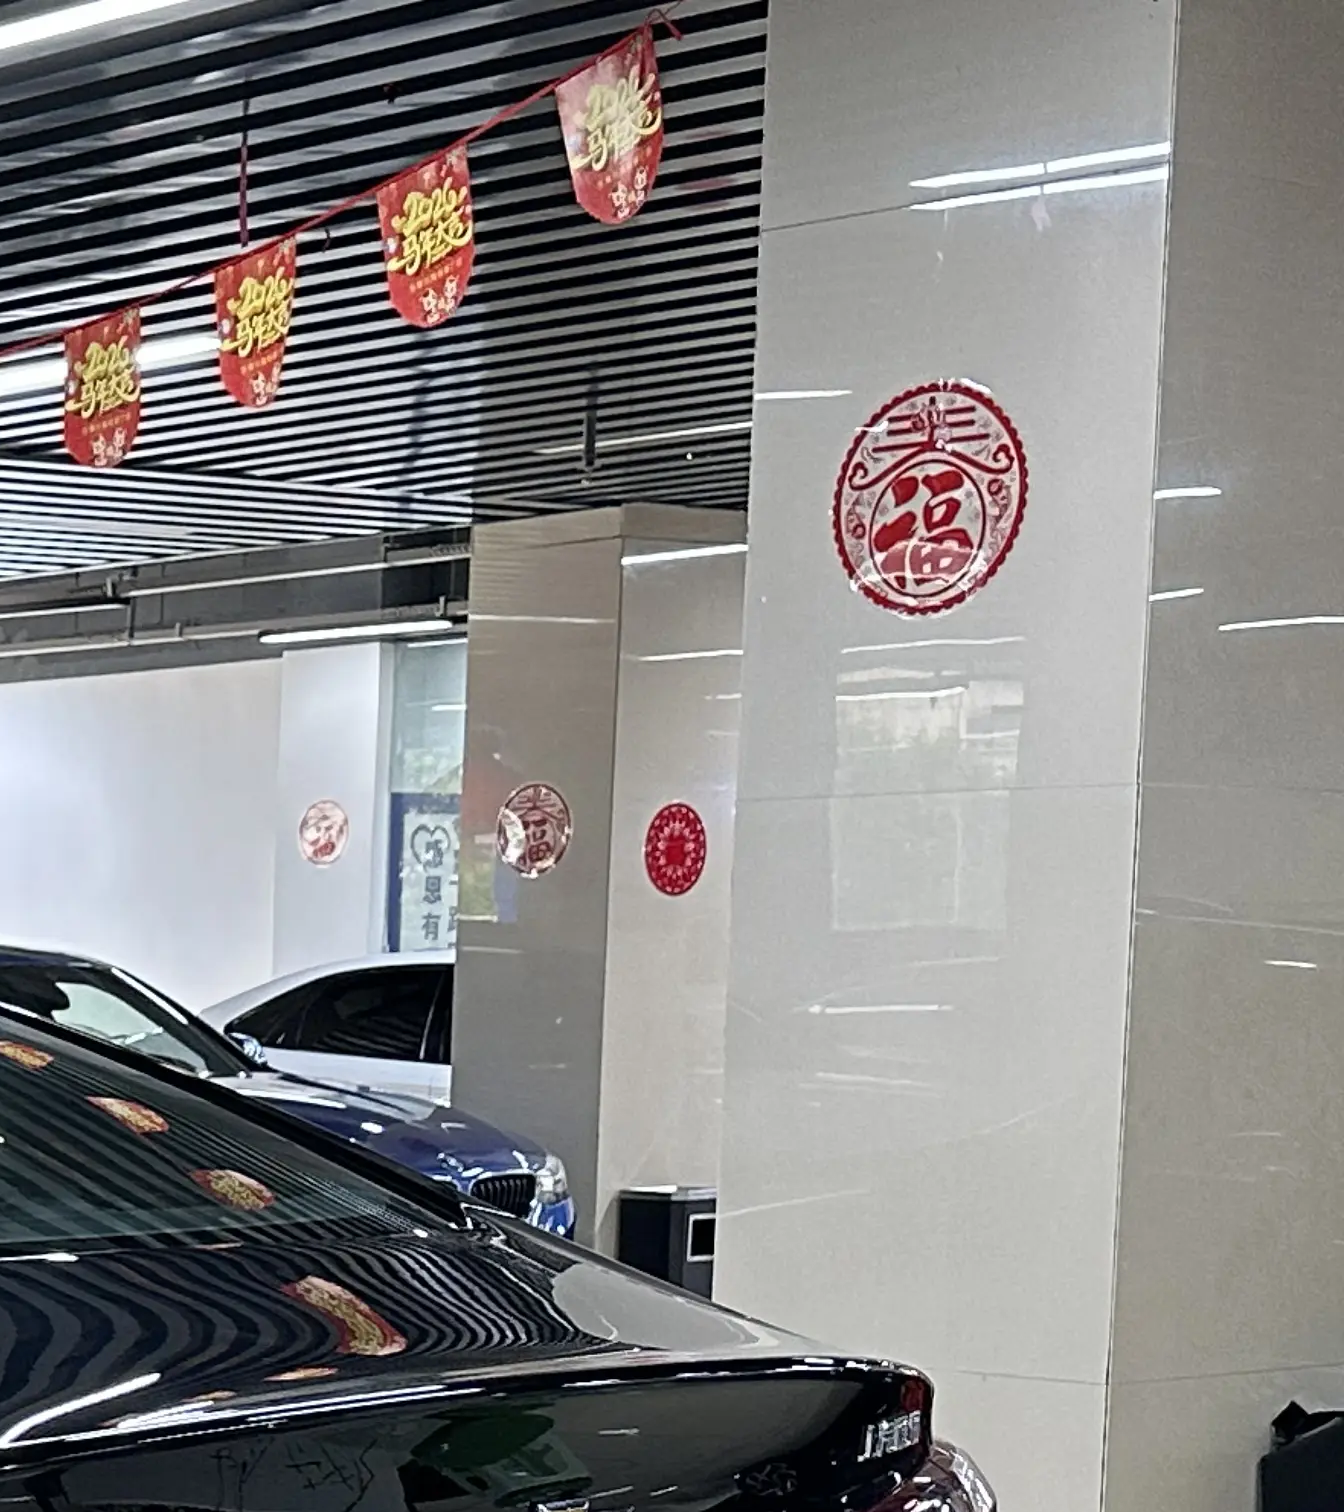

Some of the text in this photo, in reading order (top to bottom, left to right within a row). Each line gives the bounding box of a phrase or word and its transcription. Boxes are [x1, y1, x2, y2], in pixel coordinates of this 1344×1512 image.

[392, 177, 467, 236] 2026
[387, 212, 472, 275] 马年大吉
[226, 266, 292, 321] 2026
[872, 469, 975, 590] 福
